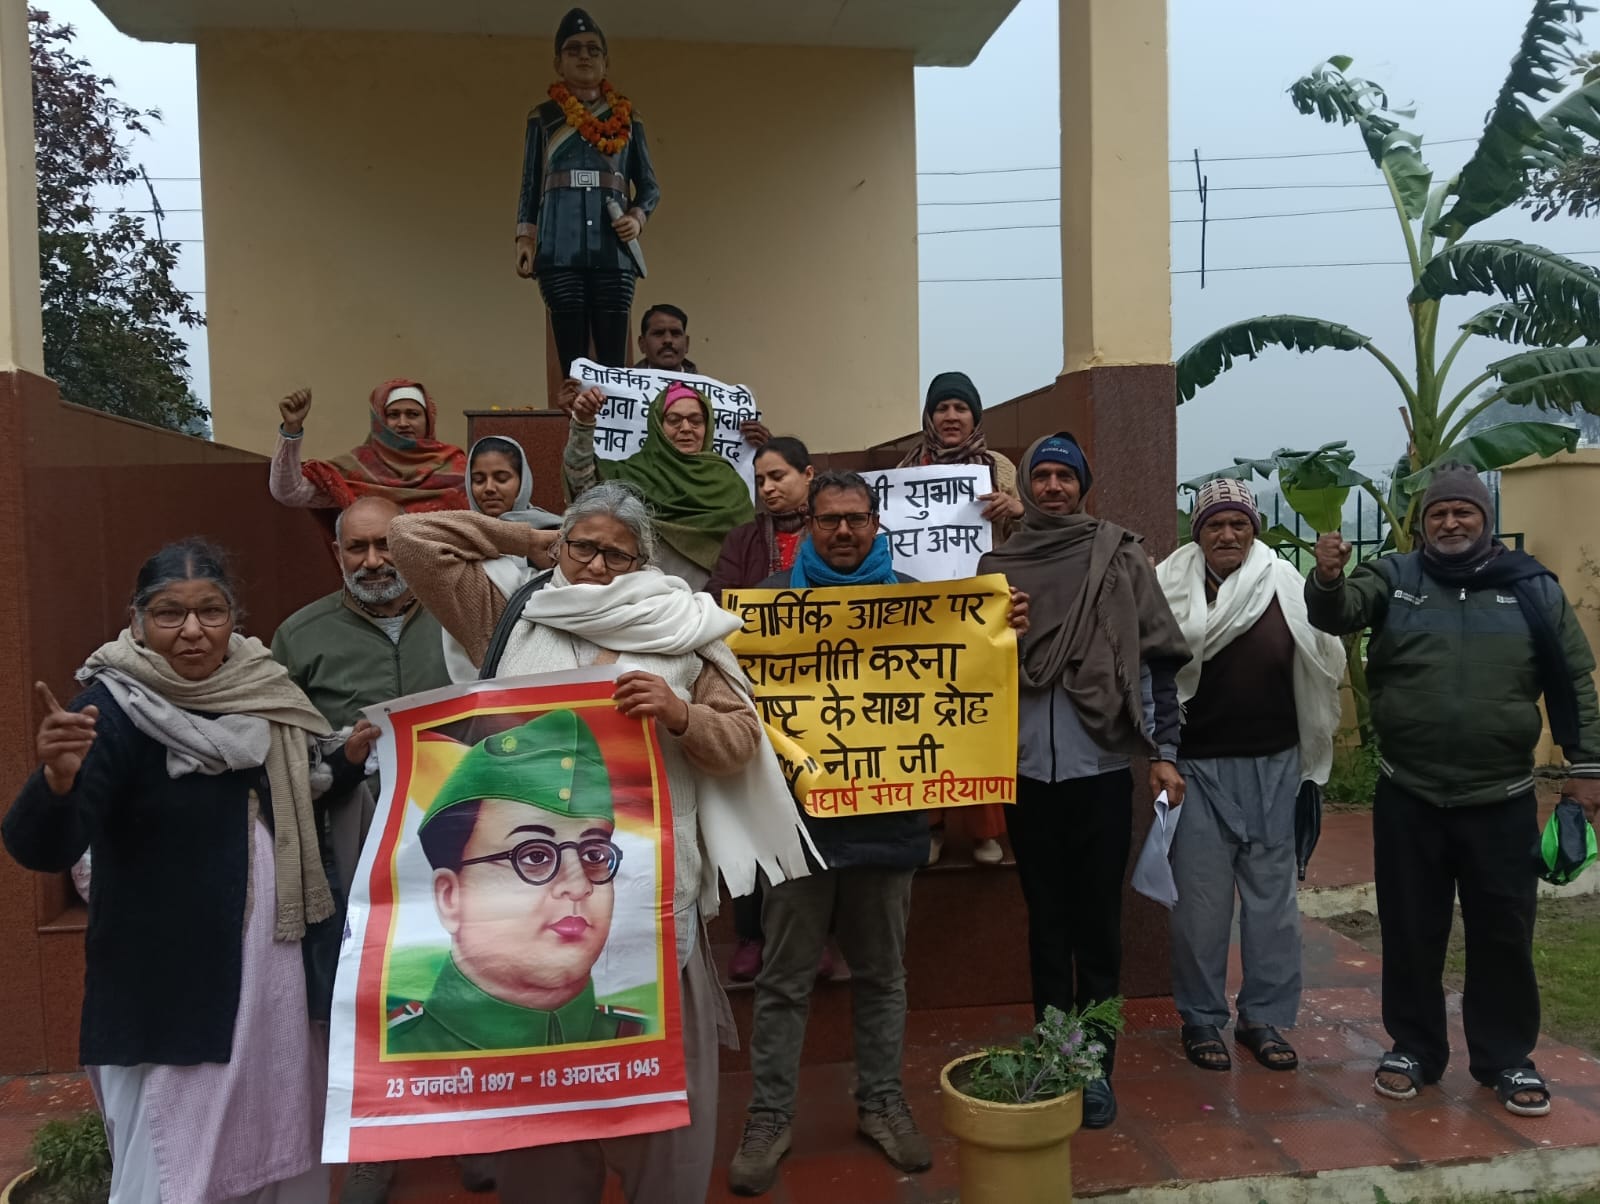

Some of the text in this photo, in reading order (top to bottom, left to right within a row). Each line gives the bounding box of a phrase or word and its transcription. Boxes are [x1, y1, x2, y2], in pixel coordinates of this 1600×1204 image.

[903, 476, 978, 521] सुभाष
[880, 522, 983, 560] ोस अमर
[847, 594, 940, 630] आधार
[946, 592, 995, 626] पर
[737, 637, 967, 687] राजनीति करना
[820, 682, 856, 732] के
[861, 691, 926, 725] साथ
[933, 681, 995, 728] द्रोह
[820, 732, 887, 782] नेता
[896, 732, 945, 774] जी
[921, 768, 1016, 804] हरियाणा
[386, 1078, 405, 1098] 23
[409, 1066, 475, 1097] जनवरी
[480, 1072, 516, 1092] 1897
[539, 1069, 557, 1088] 18
[561, 1062, 621, 1086] अगस्त
[625, 1057, 661, 1080] 1945
